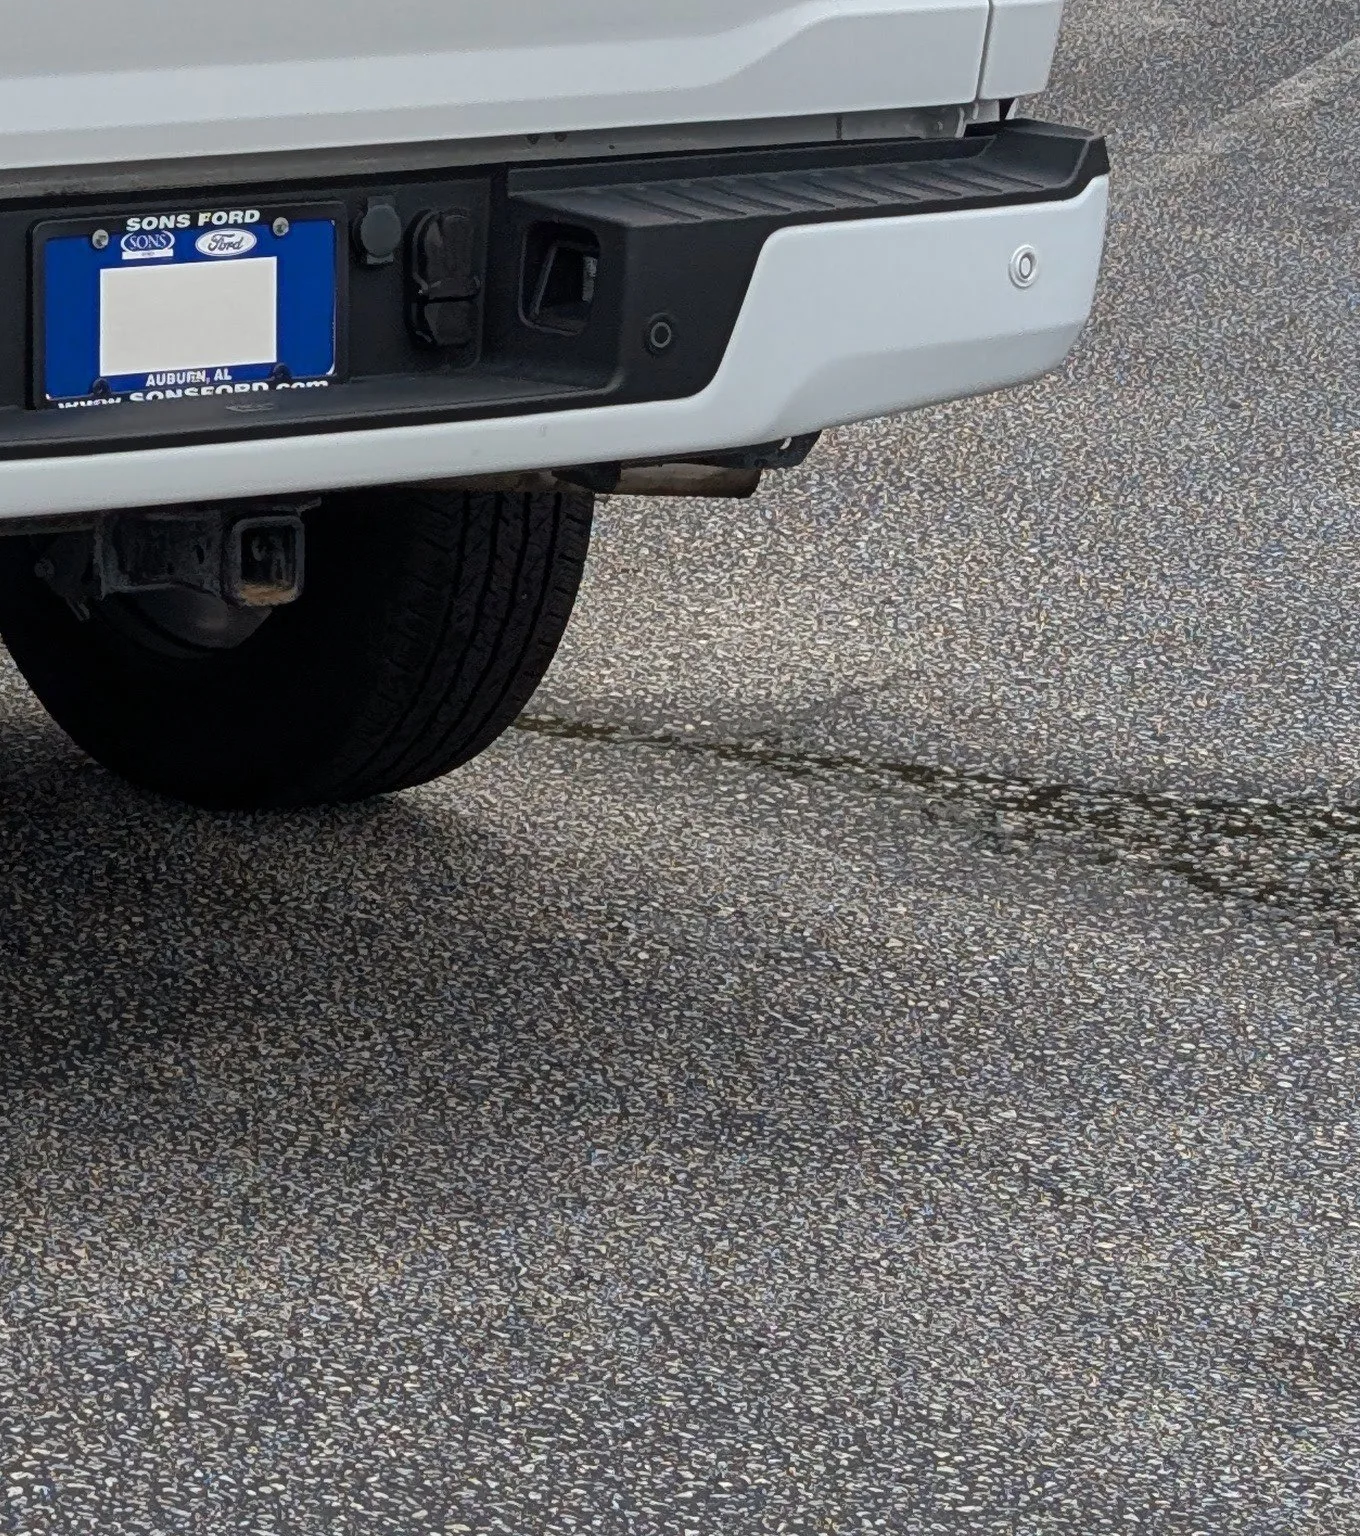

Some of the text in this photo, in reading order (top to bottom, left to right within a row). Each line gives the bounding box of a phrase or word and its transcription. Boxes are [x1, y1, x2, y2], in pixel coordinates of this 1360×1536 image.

[126, 209, 261, 232] SONS FORD
[129, 232, 167, 250] SONS
[207, 232, 245, 252] Ford
[213, 368, 233, 382] AL
